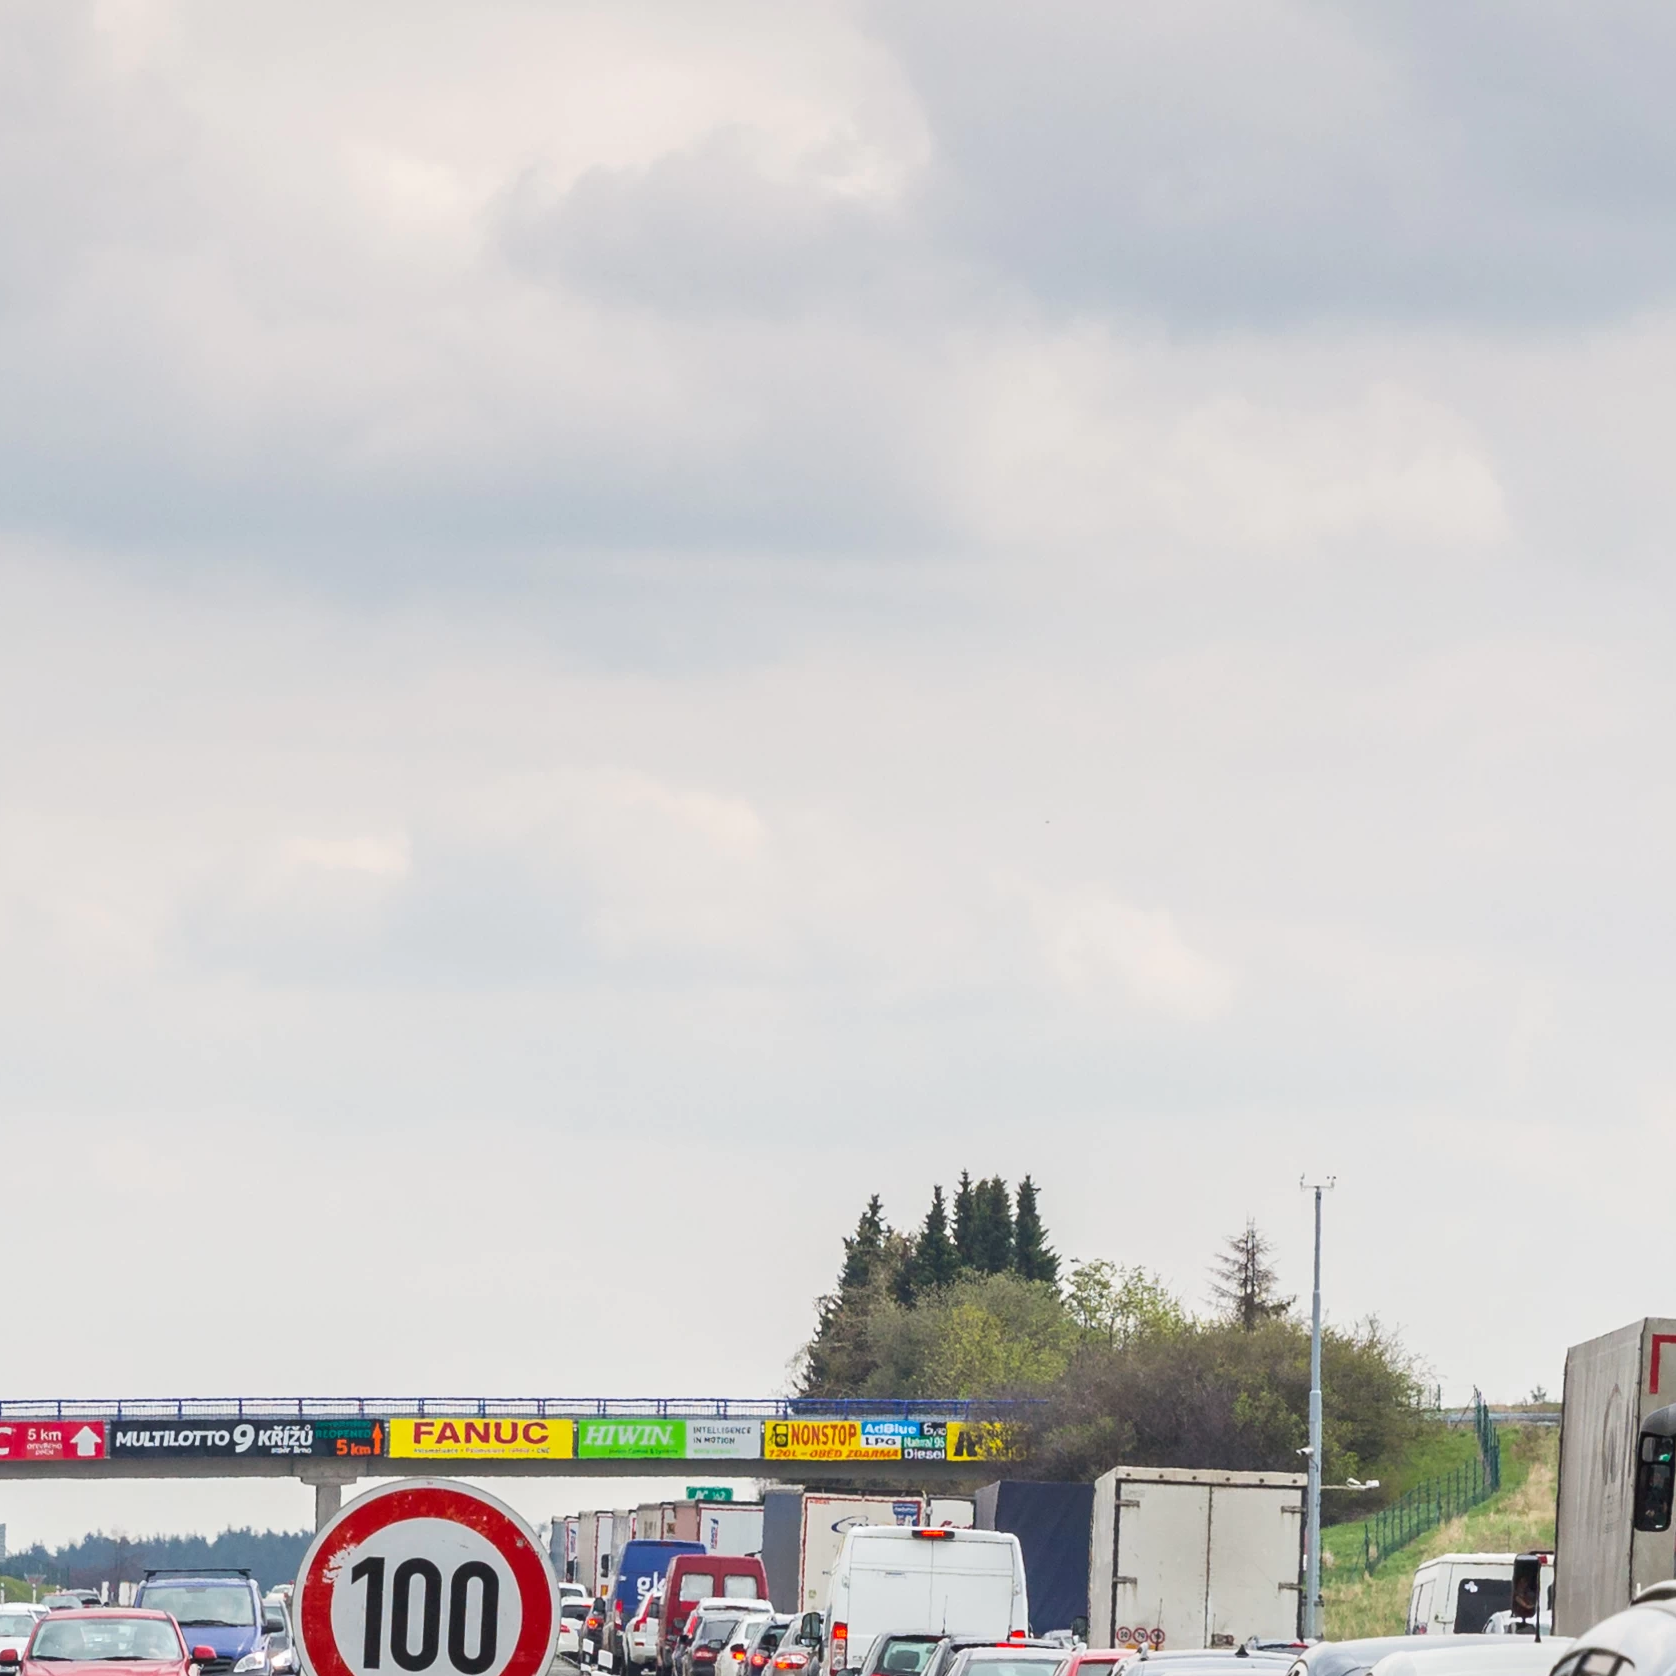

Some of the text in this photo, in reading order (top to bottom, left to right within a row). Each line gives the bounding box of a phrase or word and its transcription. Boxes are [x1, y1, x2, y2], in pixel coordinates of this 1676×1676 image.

[27, 1428, 62, 1441] 5 km
[413, 1421, 549, 1444] FANUC
[583, 1425, 674, 1446] HIWIN
[693, 1426, 752, 1435] INTELLIGENCE
[791, 1423, 857, 1447] NONSTOP
[864, 1423, 917, 1435] AdBlue
[115, 1424, 314, 1453] MULTILOTTO 9 KŘÍŽŮ
[693, 1436, 736, 1445] IN MOTION
[865, 1436, 897, 1446] LPG
[336, 1439, 372, 1456] 5 km
[768, 1449, 798, 1458] 120L
[845, 1449, 900, 1458] ZDARMA
[904, 1448, 945, 1460] Diesel
[350, 1556, 500, 1676] 100
